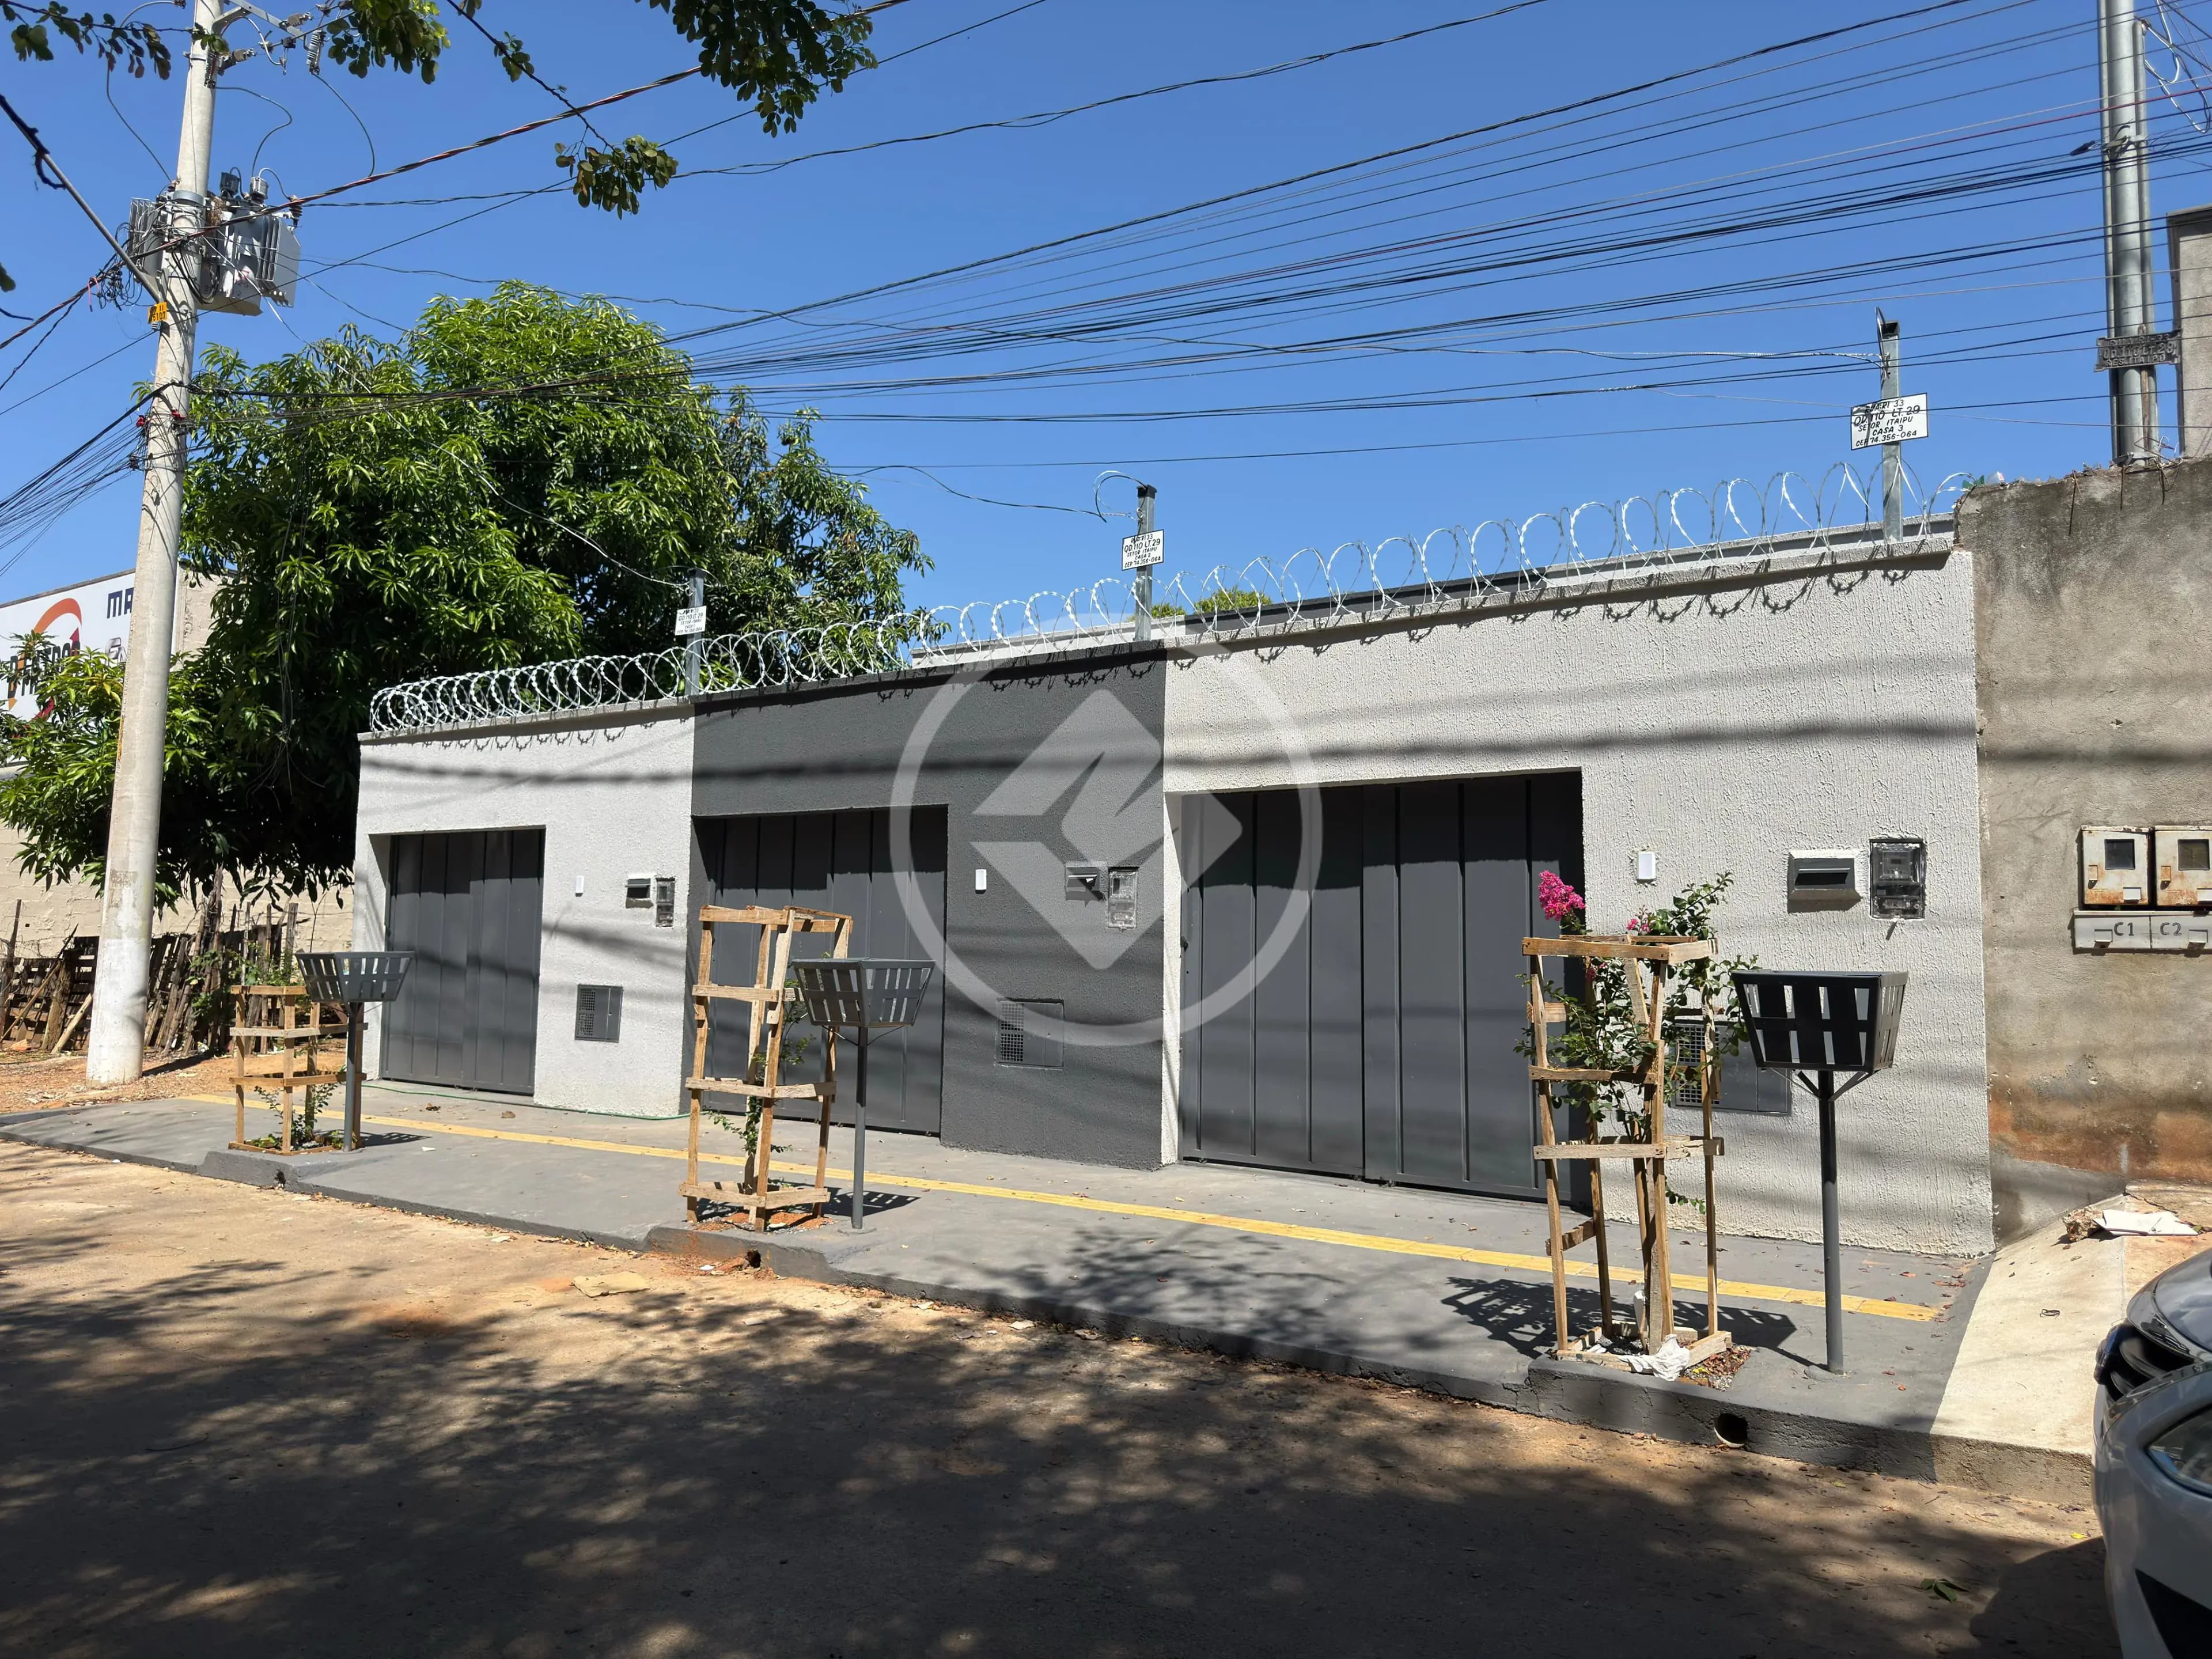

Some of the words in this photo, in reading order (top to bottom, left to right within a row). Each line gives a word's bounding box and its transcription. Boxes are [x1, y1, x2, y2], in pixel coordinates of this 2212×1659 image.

[1893, 399, 1904, 407] 33
[1858, 421, 1881, 433] SETOR
[1887, 416, 1913, 426] ITAIPU
[1872, 426, 1894, 436] CASA
[1870, 430, 1918, 444] 74.356-064
[1152, 538, 1161, 546] 29
[2113, 922, 2134, 936] C1
[2160, 922, 2182, 936] C2
